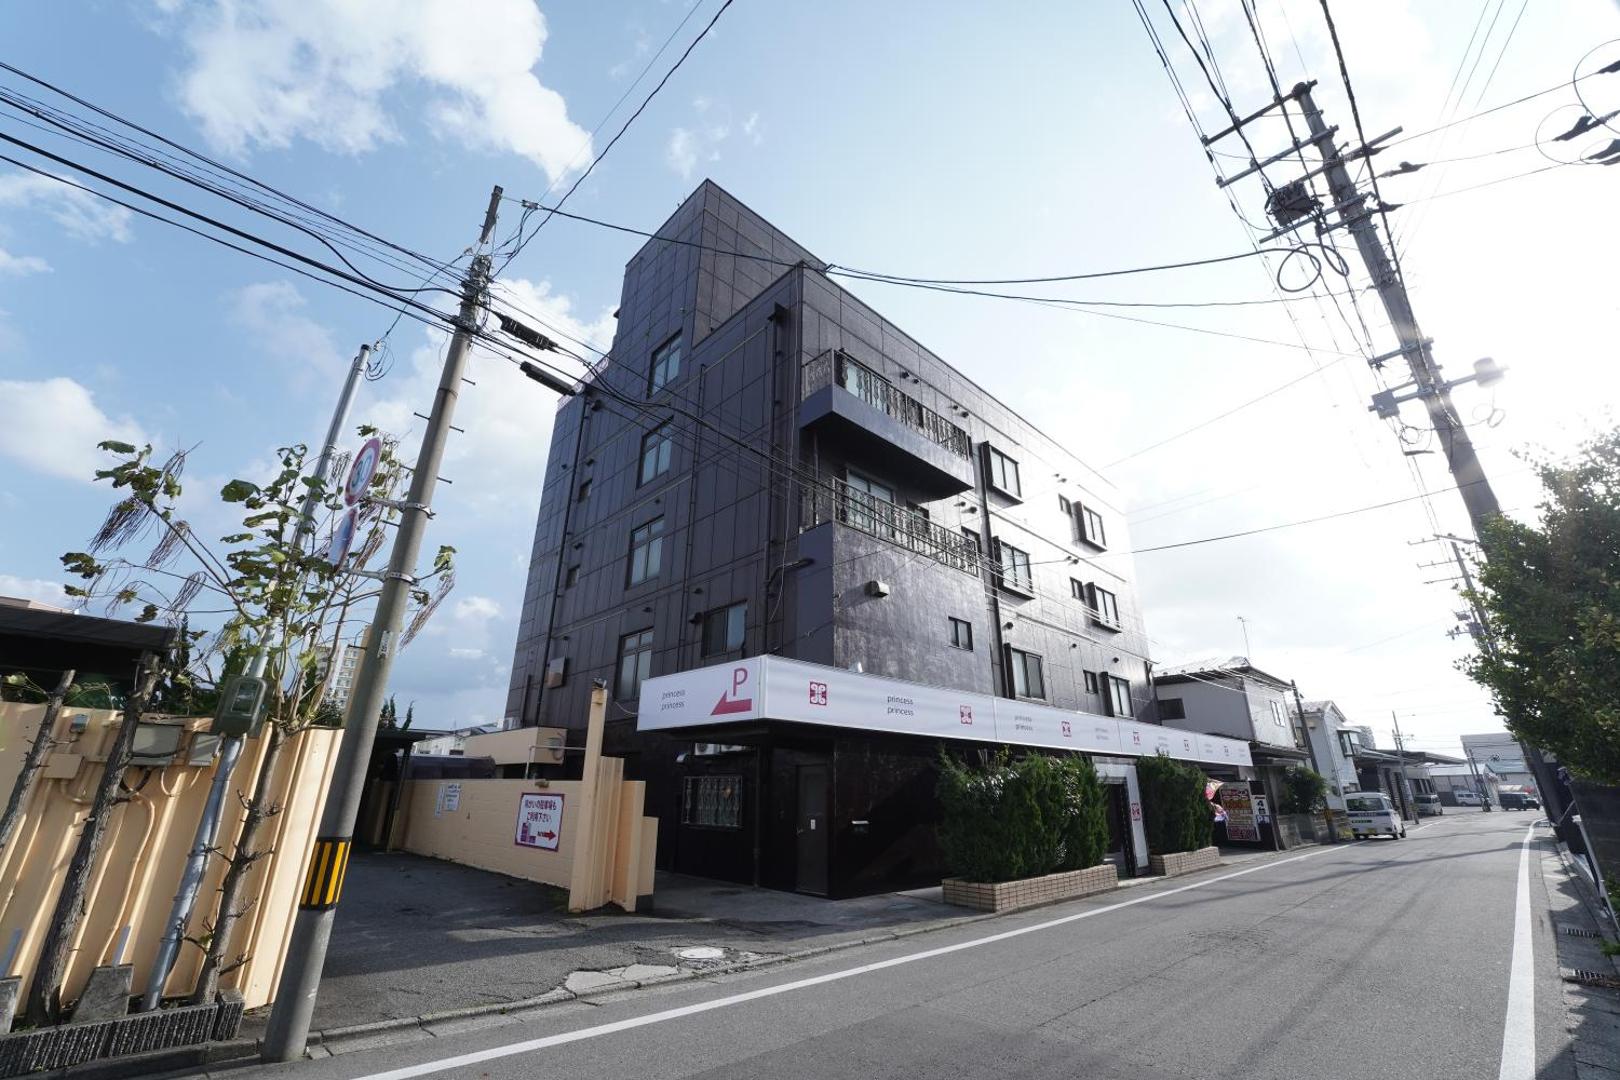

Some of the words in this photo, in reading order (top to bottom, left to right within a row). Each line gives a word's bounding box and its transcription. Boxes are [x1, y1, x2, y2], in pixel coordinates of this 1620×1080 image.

[733, 667, 748, 696] P
[887, 695, 914, 705] princess
[661, 701, 685, 711] princess
[887, 706, 914, 716] princess
